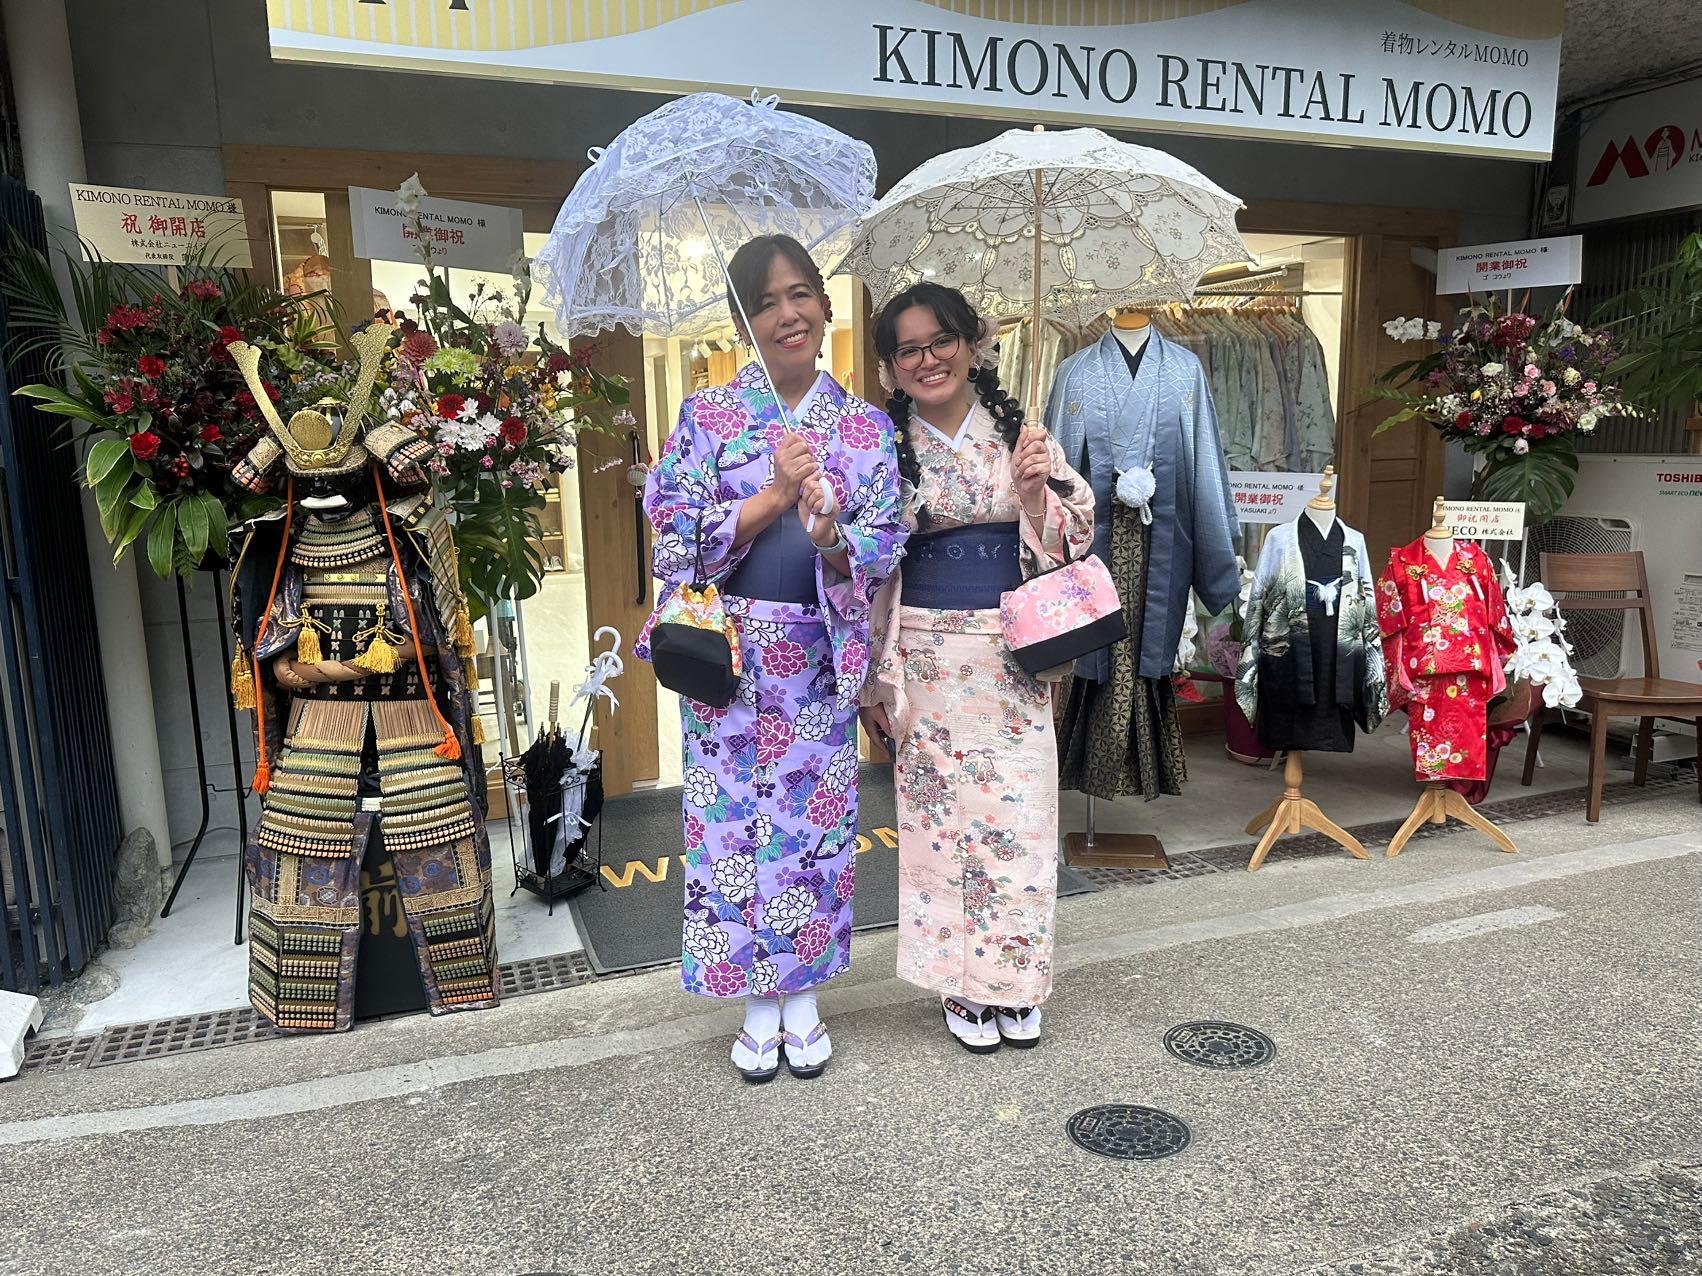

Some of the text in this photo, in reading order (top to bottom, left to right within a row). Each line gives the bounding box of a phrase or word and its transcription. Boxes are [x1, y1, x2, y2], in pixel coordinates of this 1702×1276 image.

[1381, 31, 1529, 67] 着物レンタルMOMO
[872, 24, 1532, 138] KIMONO RENTAL MOMO
[76, 189, 131, 205] KIMONO
[134, 195, 185, 210] RENTAL
[187, 199, 224, 213] MOMO
[121, 211, 206, 239] 祝 御開店
[417, 211, 446, 223] ENTAL
[447, 214, 473, 226] MOMO
[1455, 253, 1483, 261] KIMONO
[1485, 250, 1513, 259] RENTAL
[1514, 248, 1537, 256] MOMO
[1475, 258, 1528, 273] 開業御祝
[1234, 492, 1284, 505] 開業御祝
